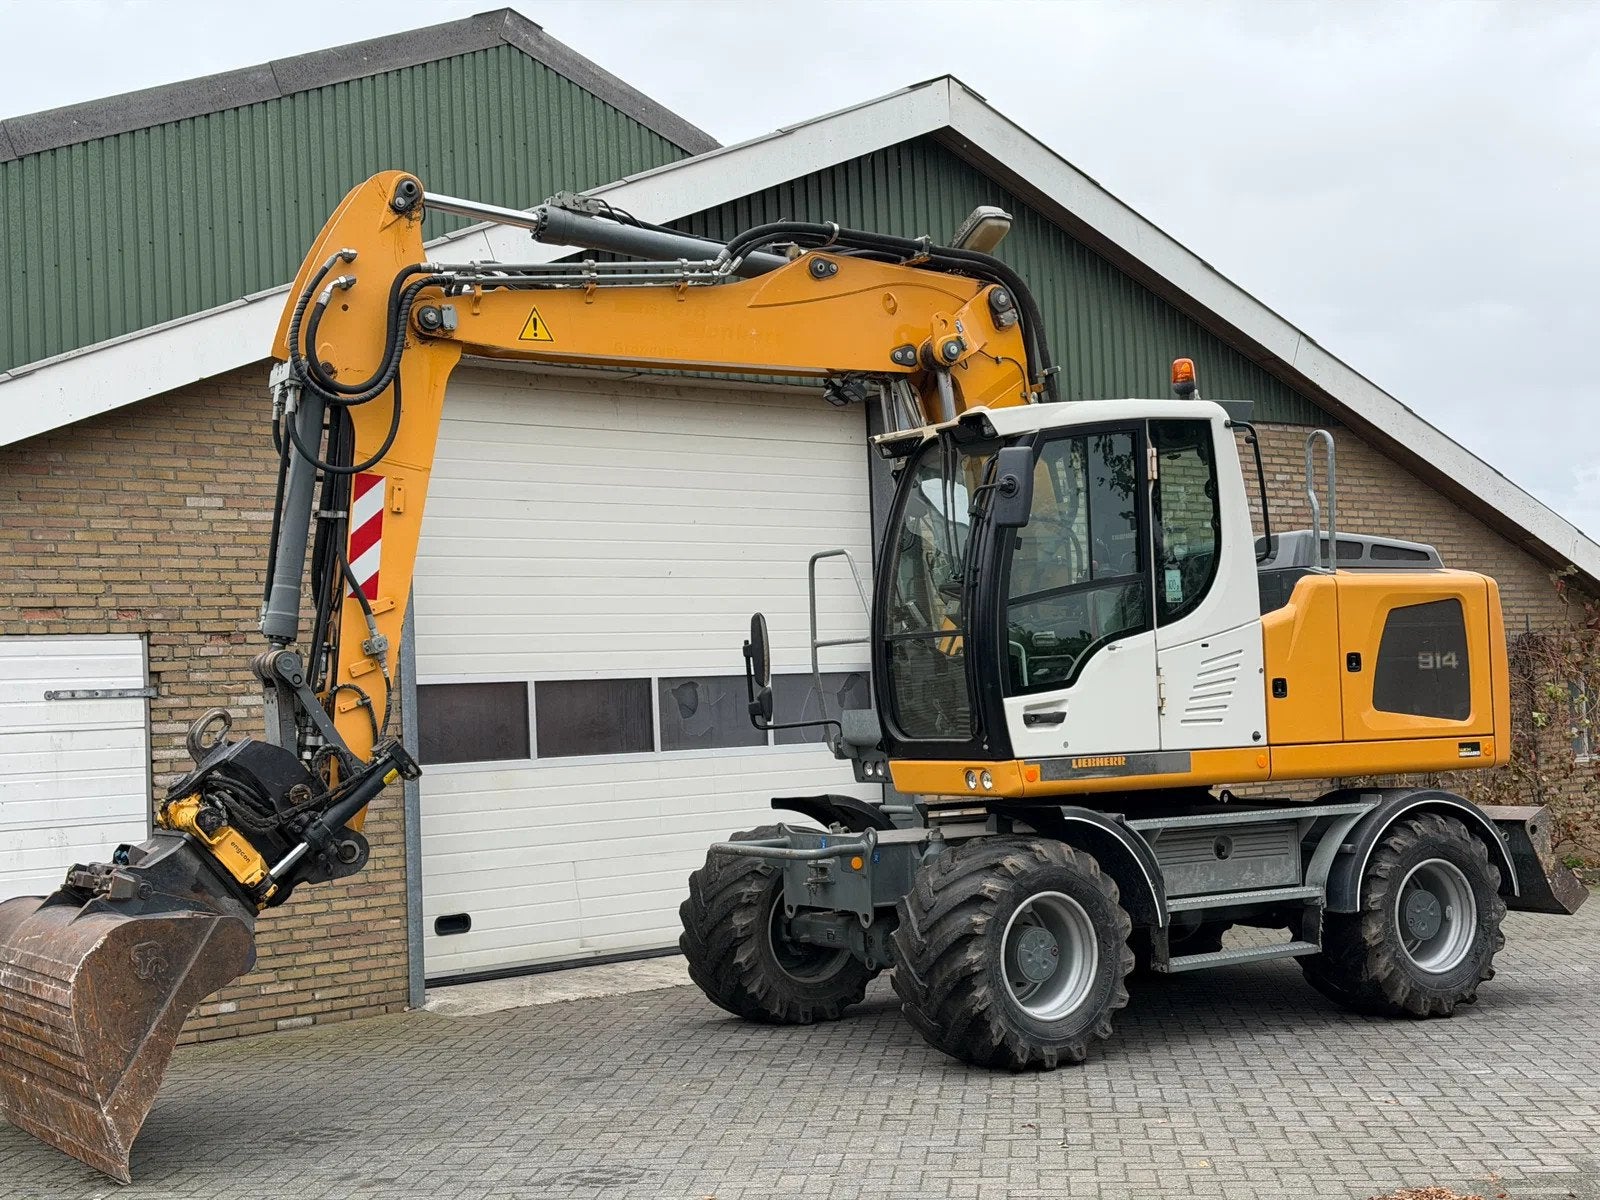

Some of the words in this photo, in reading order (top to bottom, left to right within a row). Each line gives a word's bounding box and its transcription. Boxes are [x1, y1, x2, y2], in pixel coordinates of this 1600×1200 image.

[1418, 651, 1459, 670] 914
[1071, 756, 1126, 769] LIEBHERR
[230, 841, 251, 864] engcon
